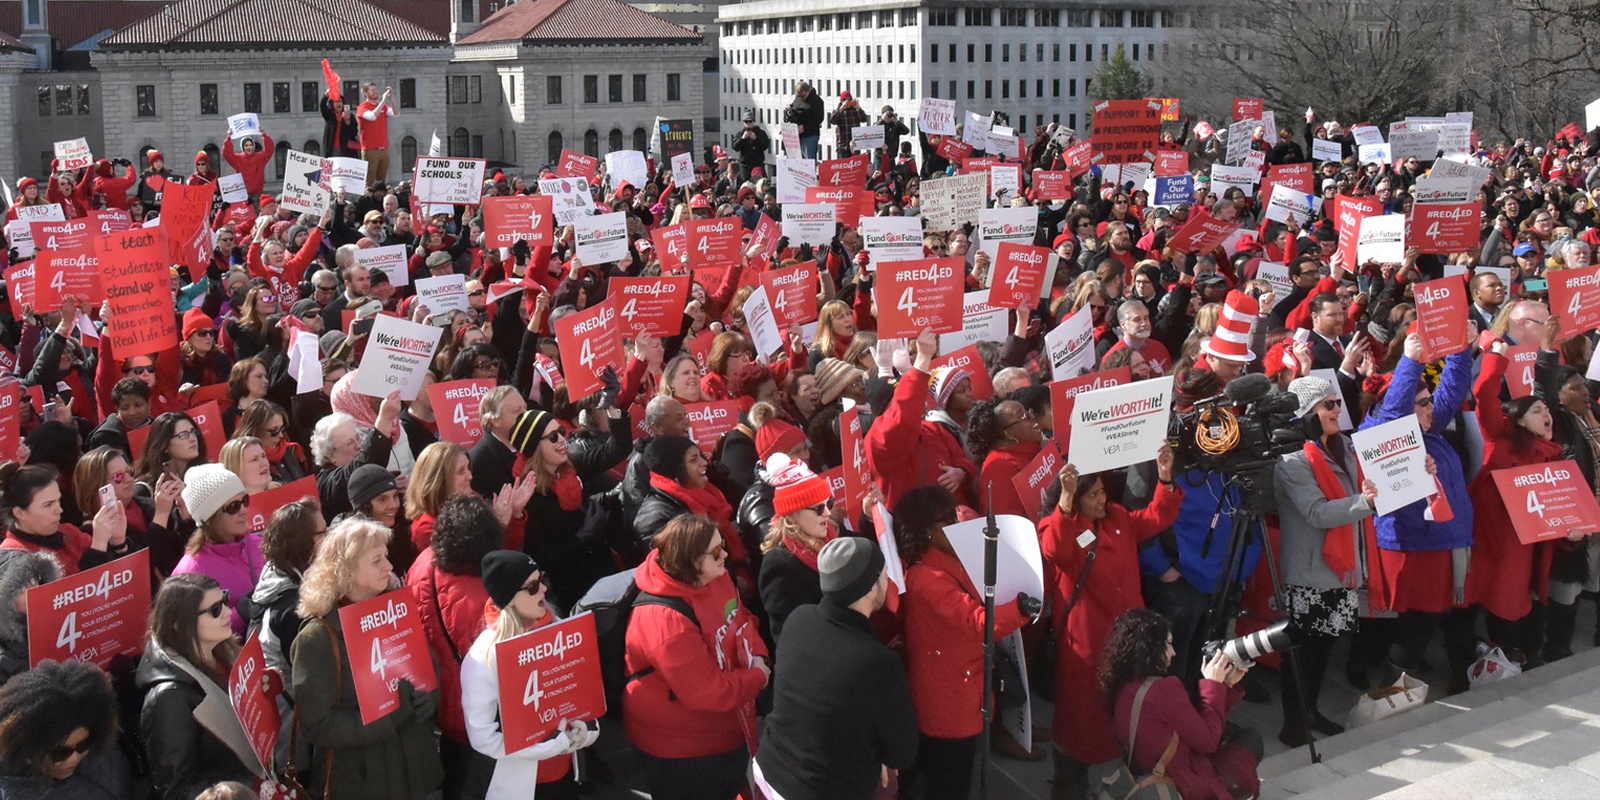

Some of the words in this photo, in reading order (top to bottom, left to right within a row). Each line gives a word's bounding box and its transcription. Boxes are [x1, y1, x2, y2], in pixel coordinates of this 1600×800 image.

[1103, 111, 1140, 119] SUPPORT
[1145, 109, 1156, 118] VA
[665, 131, 692, 141] STUDENTS
[1092, 142, 1113, 151] NEED
[1115, 142, 1138, 150] MORE
[1141, 141, 1153, 149] SS
[65, 156, 88, 169] KIDS
[289, 152, 308, 162] Hear
[309, 157, 318, 167] us
[1106, 155, 1122, 164] FOR
[1126, 154, 1143, 163] RPS
[1248, 149, 1265, 162] SAVE
[426, 160, 450, 169] FUND
[458, 161, 476, 170] OUR
[830, 160, 863, 171] #RED4ED
[421, 170, 462, 179] SCHOOLS
[830, 171, 841, 185] 4
[1167, 178, 1188, 186] Fund
[283, 195, 311, 208] NOVEMBER
[815, 189, 854, 201] #RED4ED
[1162, 192, 1190, 200] Future
[1447, 191, 1468, 199] Future
[18, 206, 49, 216] FUND
[786, 210, 833, 220] We'reWORTHIt!
[1299, 204, 1317, 213] Fut
[1340, 201, 1373, 213] #RED4ED
[1427, 207, 1473, 221] #RED4ED
[97, 212, 127, 221] #RED4ED
[529, 209, 543, 230] 4
[12, 231, 30, 239] Fund
[42, 223, 86, 235] #RED4ED
[101, 221, 111, 234] 4
[577, 233, 594, 241] Fund
[607, 228, 626, 236] Future
[662, 226, 686, 239] #RED4
[696, 221, 734, 235] #RED4ED
[983, 227, 1003, 235] Fund
[1019, 224, 1036, 233] Future
[1379, 230, 1402, 238] Future
[1426, 221, 1441, 240] 4
[46, 236, 59, 251] 4
[101, 235, 114, 252] I
[120, 233, 154, 249] teach
[697, 236, 710, 254] 4
[866, 234, 886, 242] Fund
[902, 233, 922, 242] Future
[1189, 231, 1204, 244] 4
[667, 240, 678, 257] 4
[1008, 250, 1043, 268] #RED4ED
[11, 263, 36, 281] #RED4
[772, 268, 810, 287] #RED4ED
[895, 263, 953, 285] #RED4ED
[1004, 266, 1020, 291] 4
[50, 271, 66, 293] 4
[106, 286, 140, 299] stand
[140, 281, 154, 294] up
[421, 283, 464, 297] We'reWORTHIt!
[623, 280, 676, 298] #RED4ED
[14, 283, 22, 303] 4
[774, 289, 787, 313] 4
[111, 298, 162, 315] themselves
[620, 298, 638, 321] 4
[897, 287, 918, 317] 4
[1567, 292, 1583, 318] 4
[113, 318, 137, 332] Here
[138, 315, 148, 324] is
[149, 313, 163, 325] my
[572, 307, 615, 337] #RED4ED
[112, 334, 135, 349] Real
[140, 329, 159, 341] Life
[376, 332, 435, 355] We'reWORTHIt!
[1052, 347, 1069, 362] Fund
[1079, 327, 1093, 344] Future
[579, 338, 596, 370] 4
[1514, 352, 1538, 363] #RED
[1522, 366, 1534, 396] 4
[453, 403, 469, 429] 4
[1081, 393, 1163, 424] We'reWORTHIt!
[1100, 419, 1146, 433] #FundOurFuture
[1105, 428, 1139, 441] #VEAStrong
[1361, 430, 1417, 462] We'reWORTHIt!
[1028, 453, 1056, 488] #RED4ED
[1513, 467, 1571, 488] #RED4ED
[1526, 490, 1545, 519] 4
[52, 570, 133, 610] #RED4ED
[360, 599, 408, 634] #RED4ED
[56, 611, 82, 654] 4
[518, 630, 583, 667] #RED4ED
[370, 637, 388, 681] 4
[522, 669, 545, 713] 4
